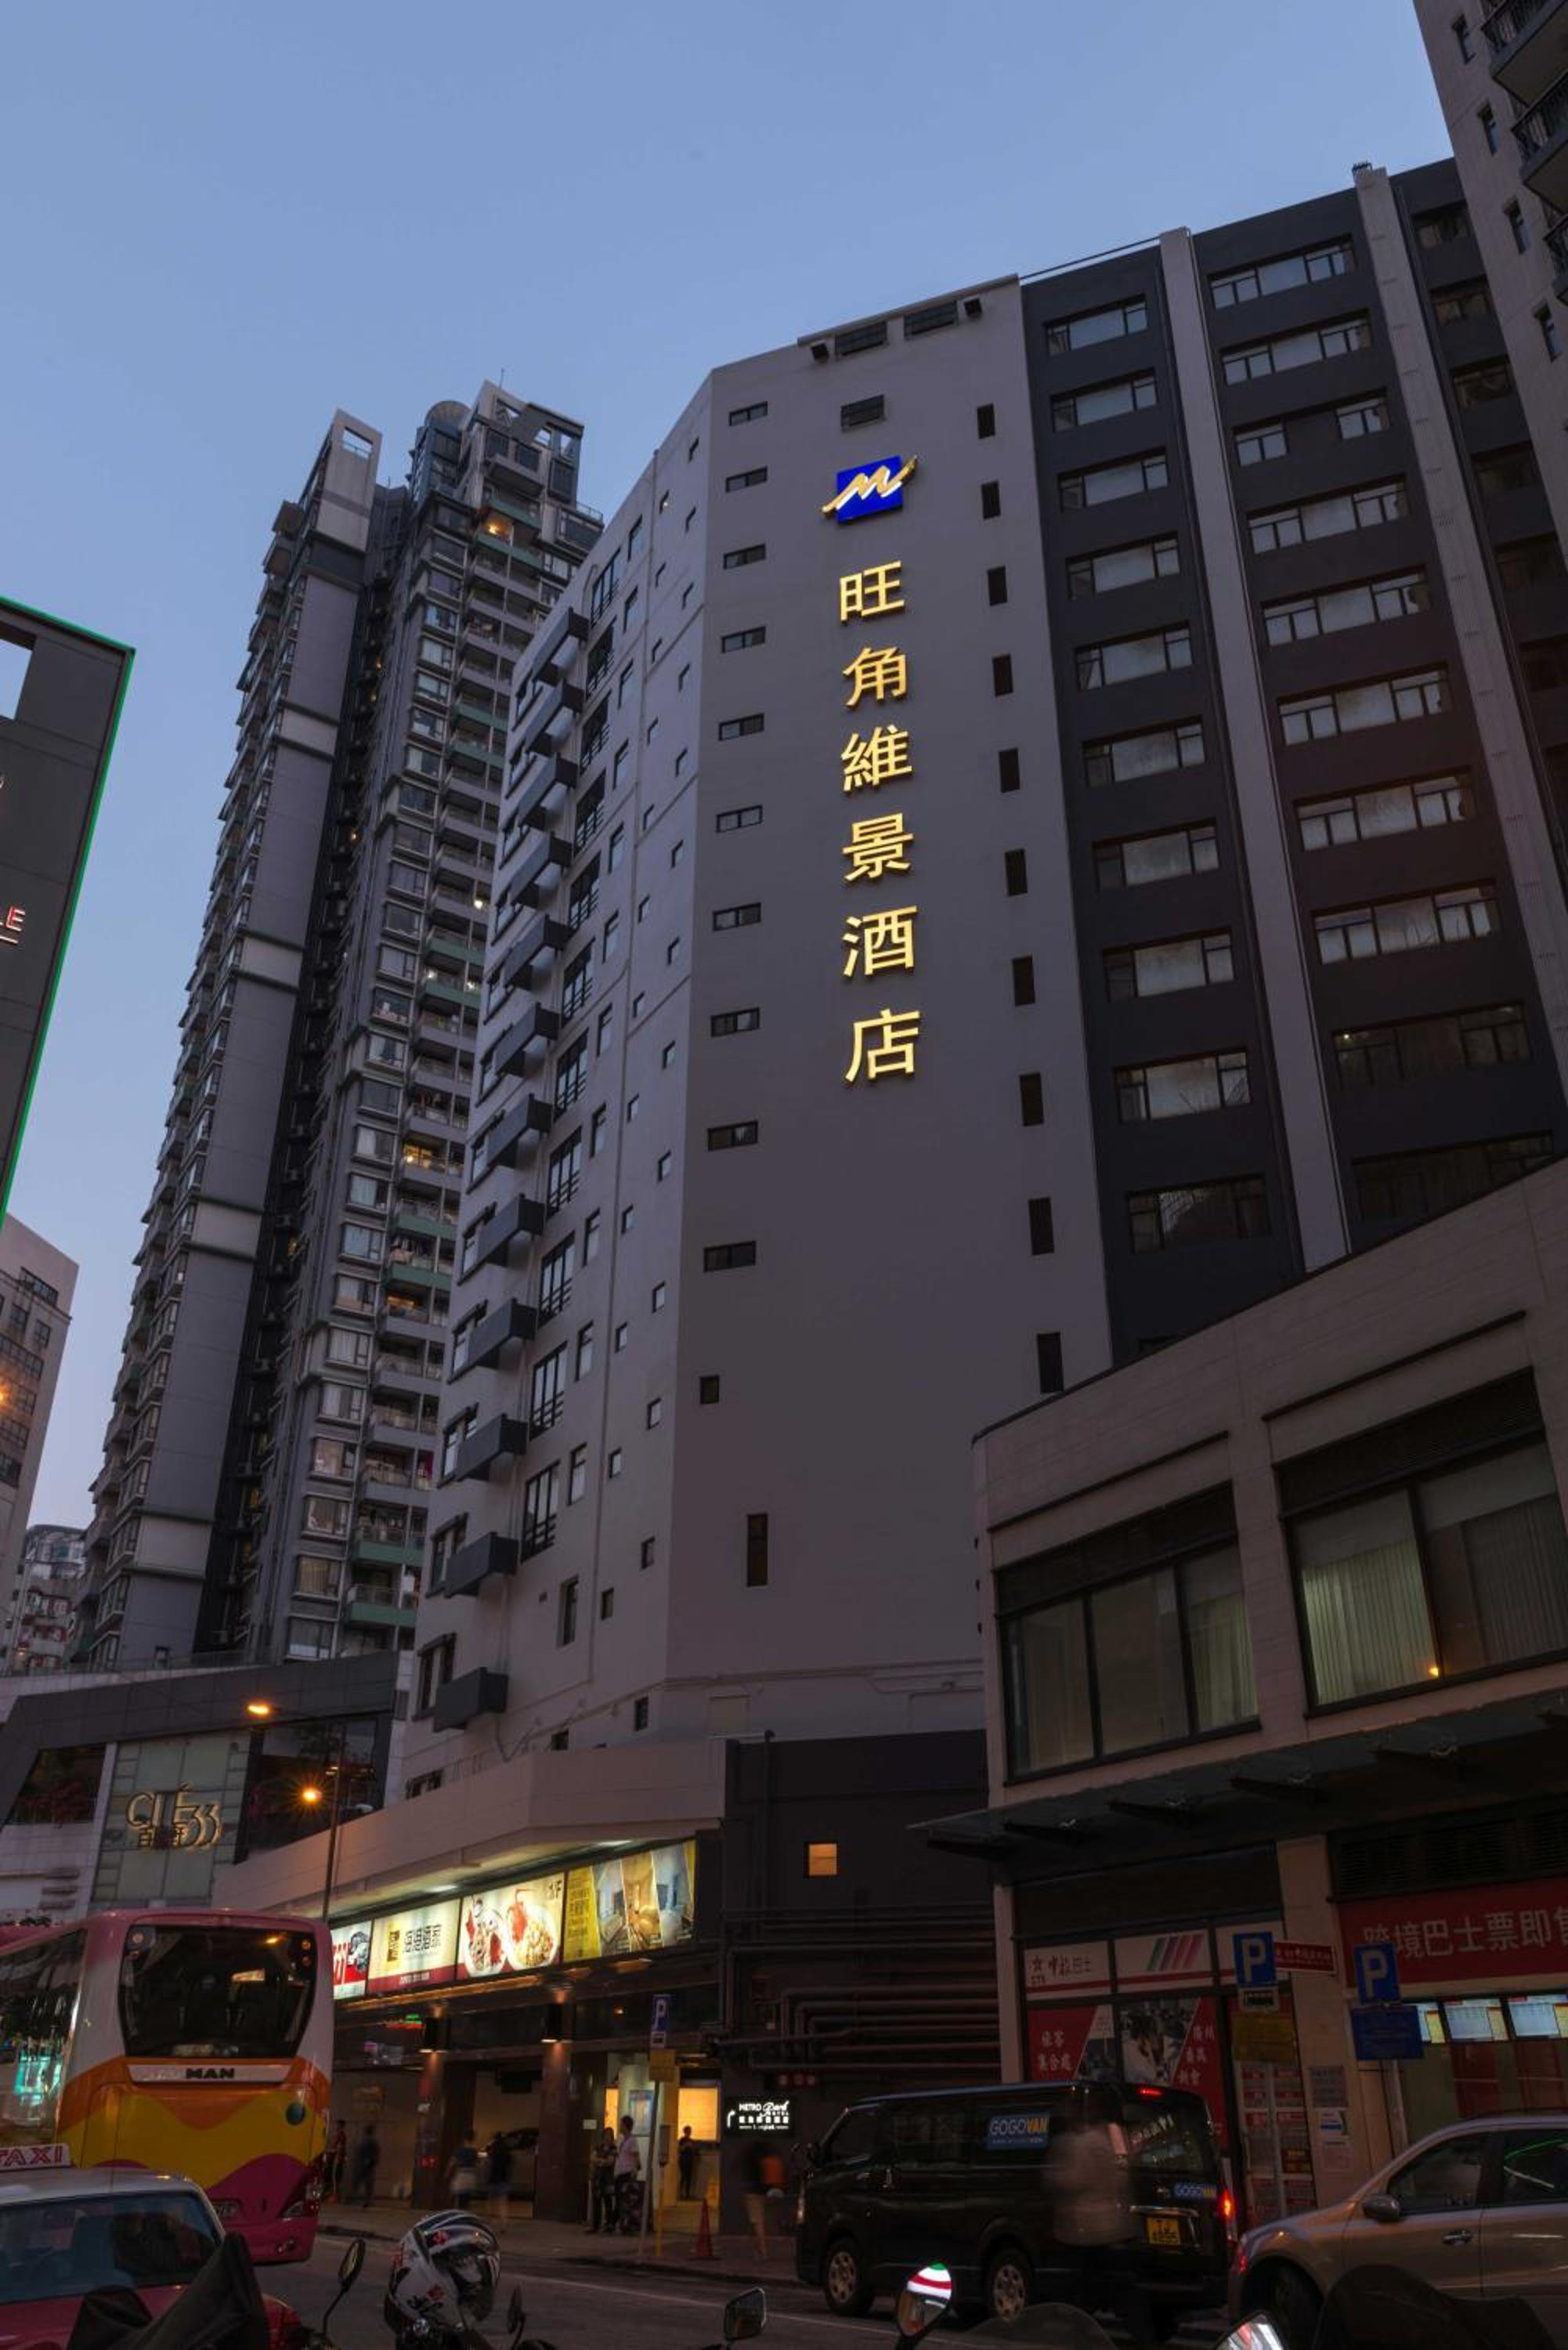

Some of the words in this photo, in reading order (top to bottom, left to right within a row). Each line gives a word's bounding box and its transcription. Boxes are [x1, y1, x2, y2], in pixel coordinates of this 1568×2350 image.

[839, 560, 920, 1083] 旺角維景酒店
[1241, 1937, 1266, 1982] P
[1361, 1948, 1387, 1998] P
[653, 1998, 667, 2030] P
[186, 2068, 234, 2078] MAN
